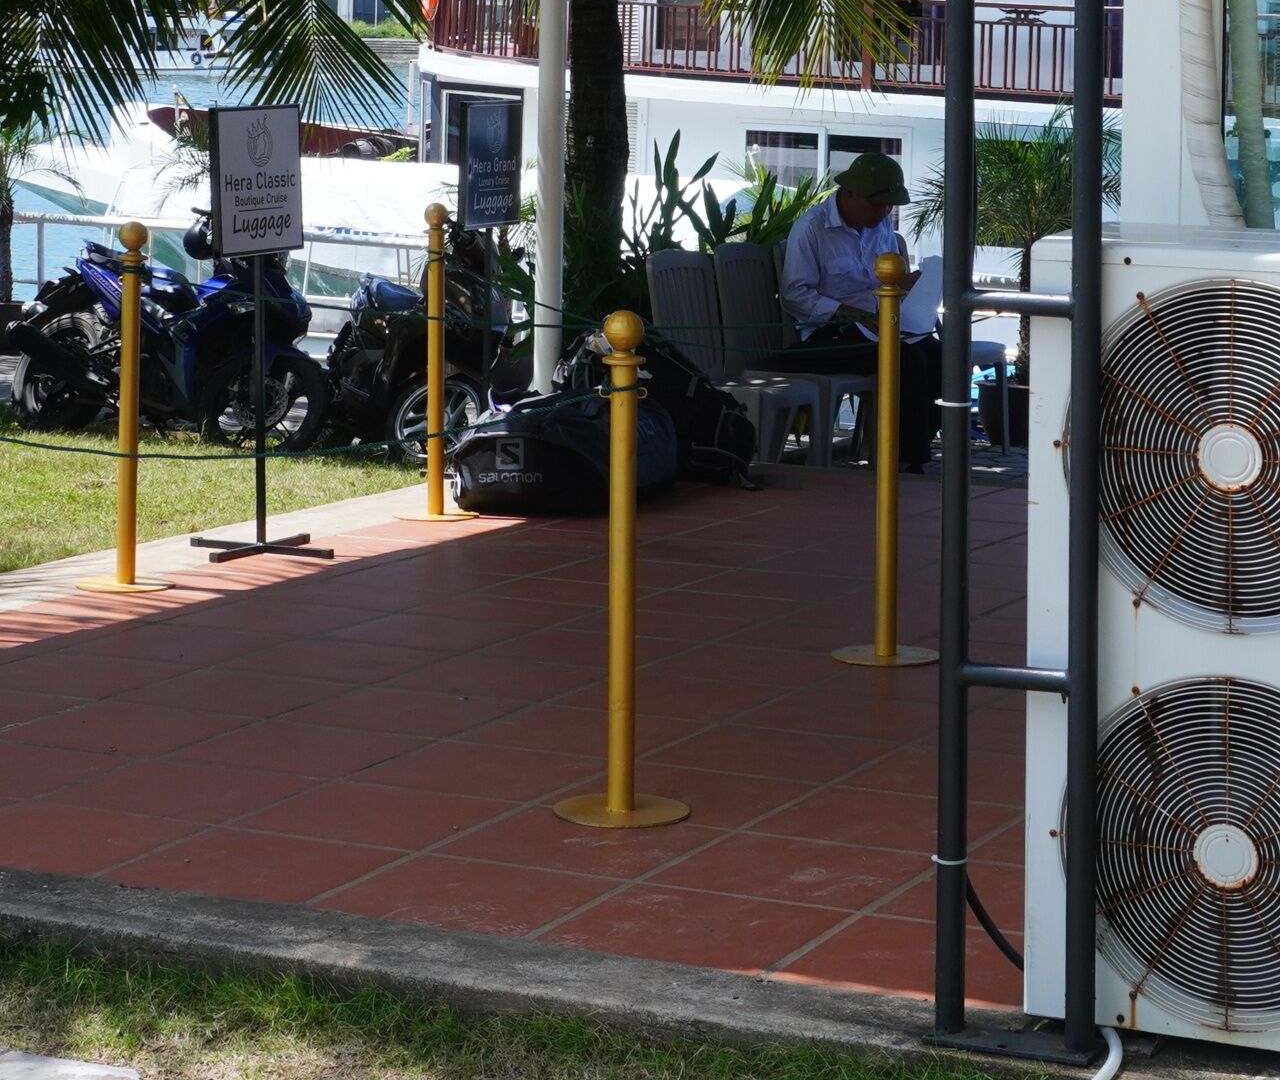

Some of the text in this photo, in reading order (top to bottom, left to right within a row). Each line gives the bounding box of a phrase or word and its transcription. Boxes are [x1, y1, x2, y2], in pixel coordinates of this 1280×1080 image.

[472, 156, 516, 173] Hera Grand
[225, 170, 296, 193] Hera Classic
[234, 192, 288, 208] Boutique Cruise
[474, 193, 513, 215] Luggage
[233, 213, 291, 240] Luggage
[478, 472, 543, 483] salomon
